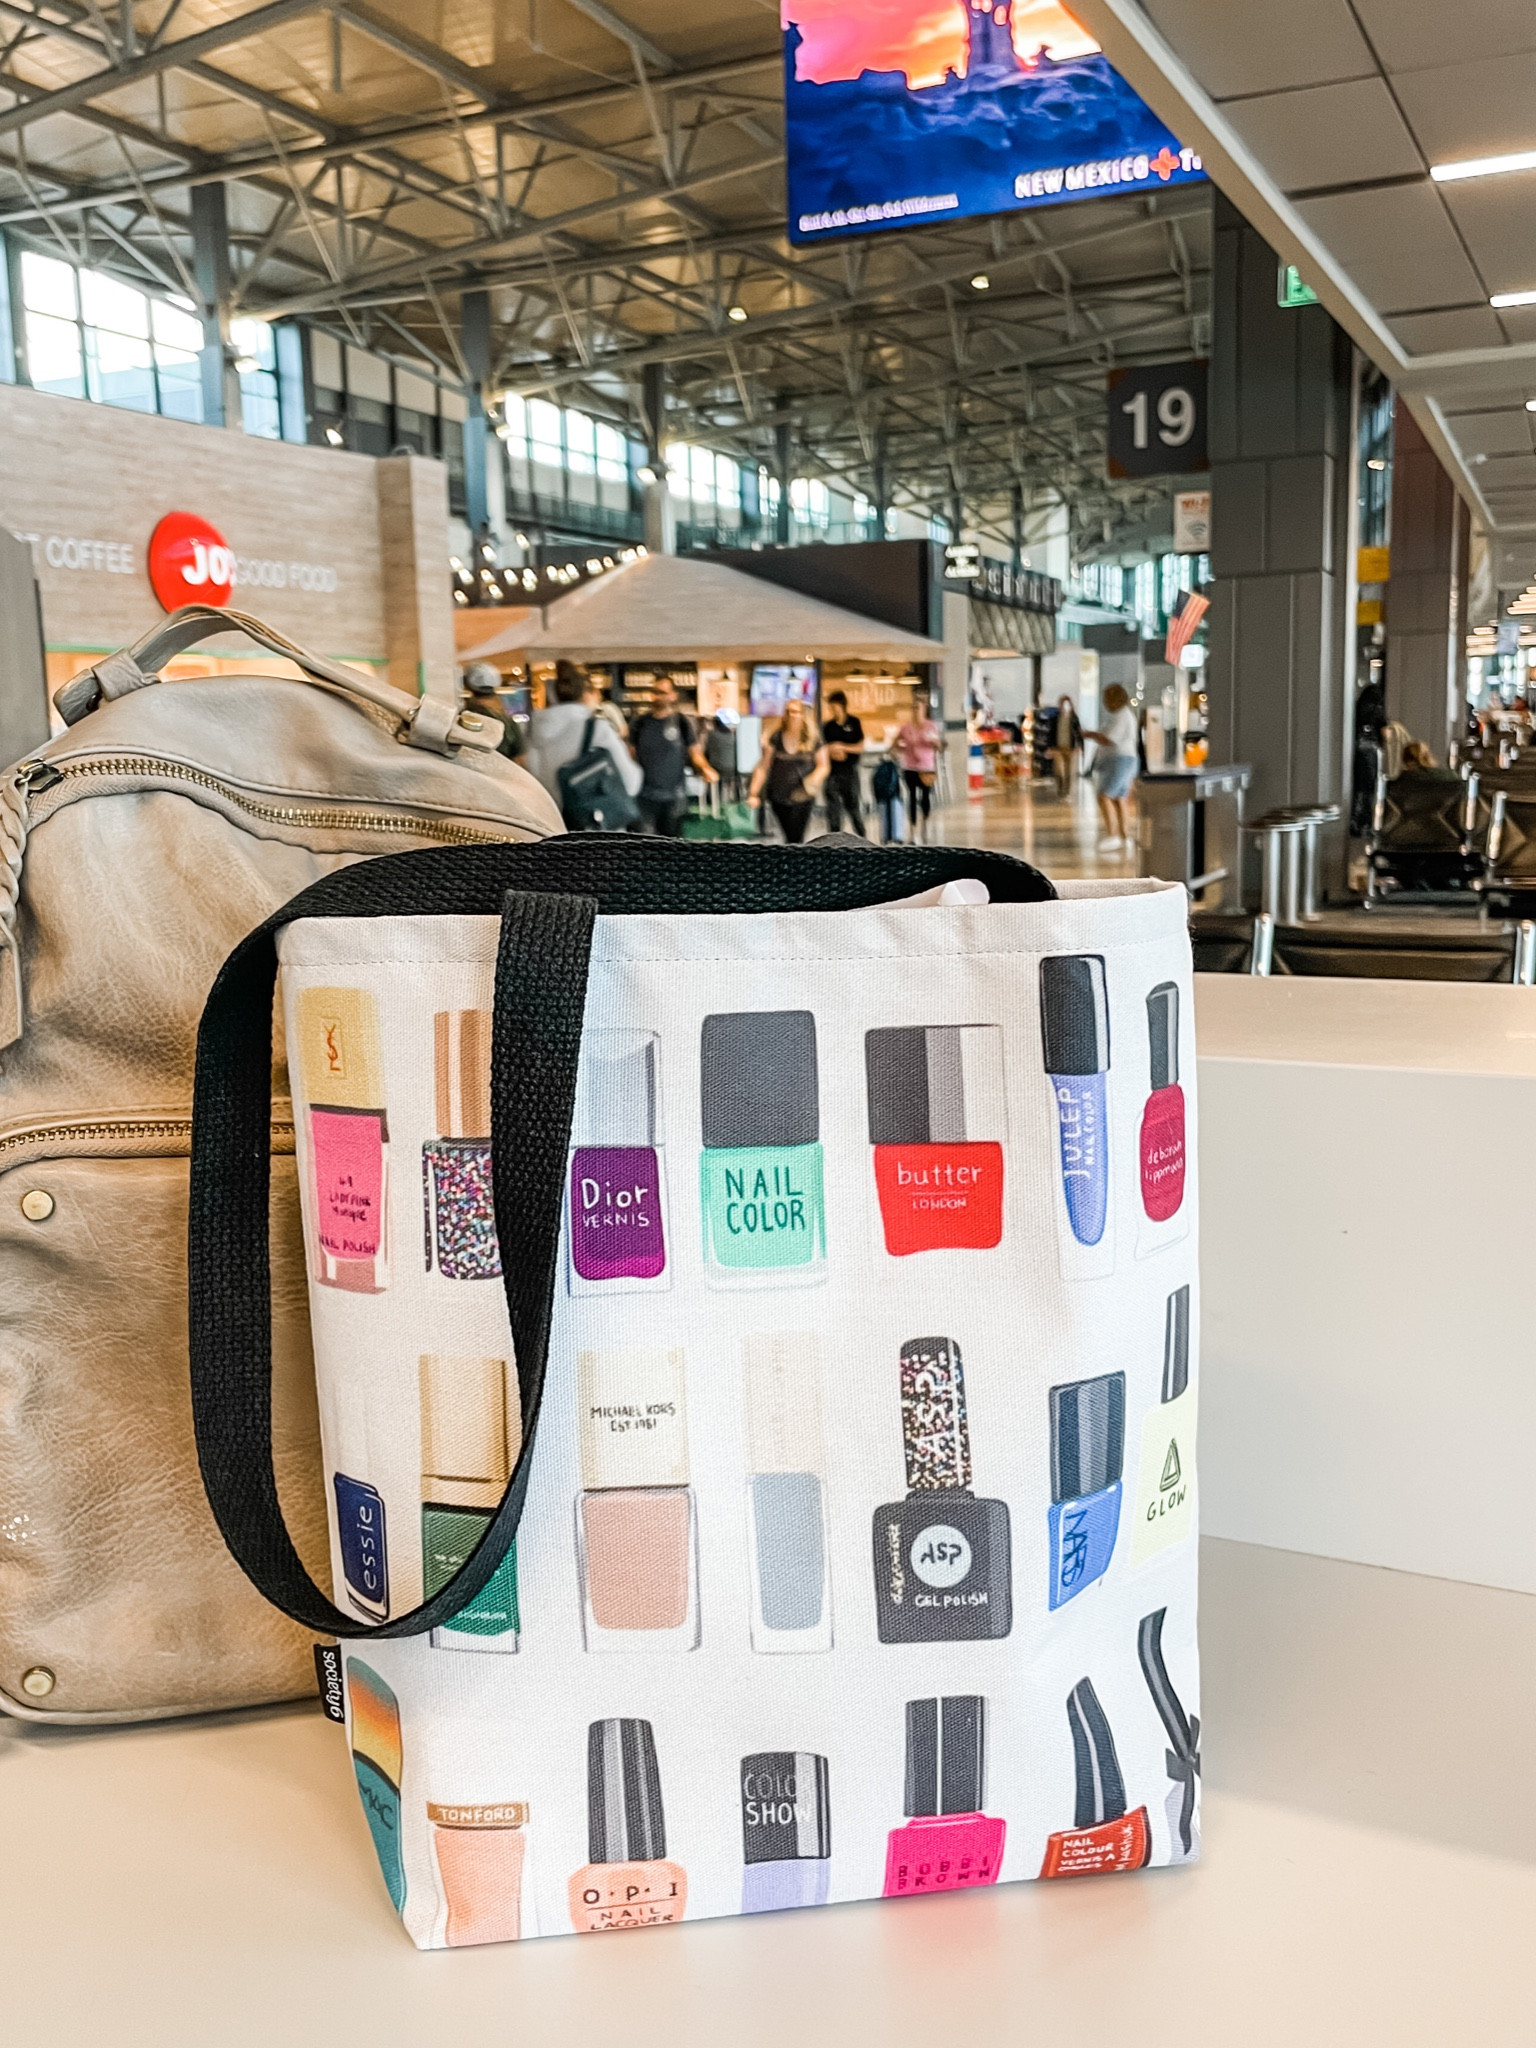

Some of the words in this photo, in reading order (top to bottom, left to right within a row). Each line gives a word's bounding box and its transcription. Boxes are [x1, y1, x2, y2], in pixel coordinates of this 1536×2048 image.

[1014, 168, 1063, 199] NEW
[1065, 154, 1149, 191] MEXICO
[1122, 386, 1196, 449] 19
[46, 538, 136, 575] COFFEE
[1057, 1086, 1091, 1179] JULEP
[725, 1166, 804, 1199] NAIL
[897, 1161, 982, 1186] butter
[581, 1177, 649, 1210] Dior
[912, 1198, 967, 1210] LONDON
[582, 1211, 650, 1229] VERNIS
[726, 1200, 806, 1235] COLOR
[645, 1401, 676, 1417] KORS
[610, 1418, 631, 1433] EST
[1146, 1484, 1187, 1522] GLOW
[356, 1504, 377, 1590] essie
[920, 1541, 963, 1566] ASP
[914, 1593, 941, 1608] GEL
[943, 1591, 989, 1608] POLISH
[322, 1650, 345, 1720] society6
[1061, 1841, 1115, 1858] COLOUR
[1062, 1836, 1095, 1849] NAIL
[899, 1856, 989, 1878] BOBBI
[590, 1914, 674, 1931] LACQUER
[600, 1907, 661, 1921] NAIL
